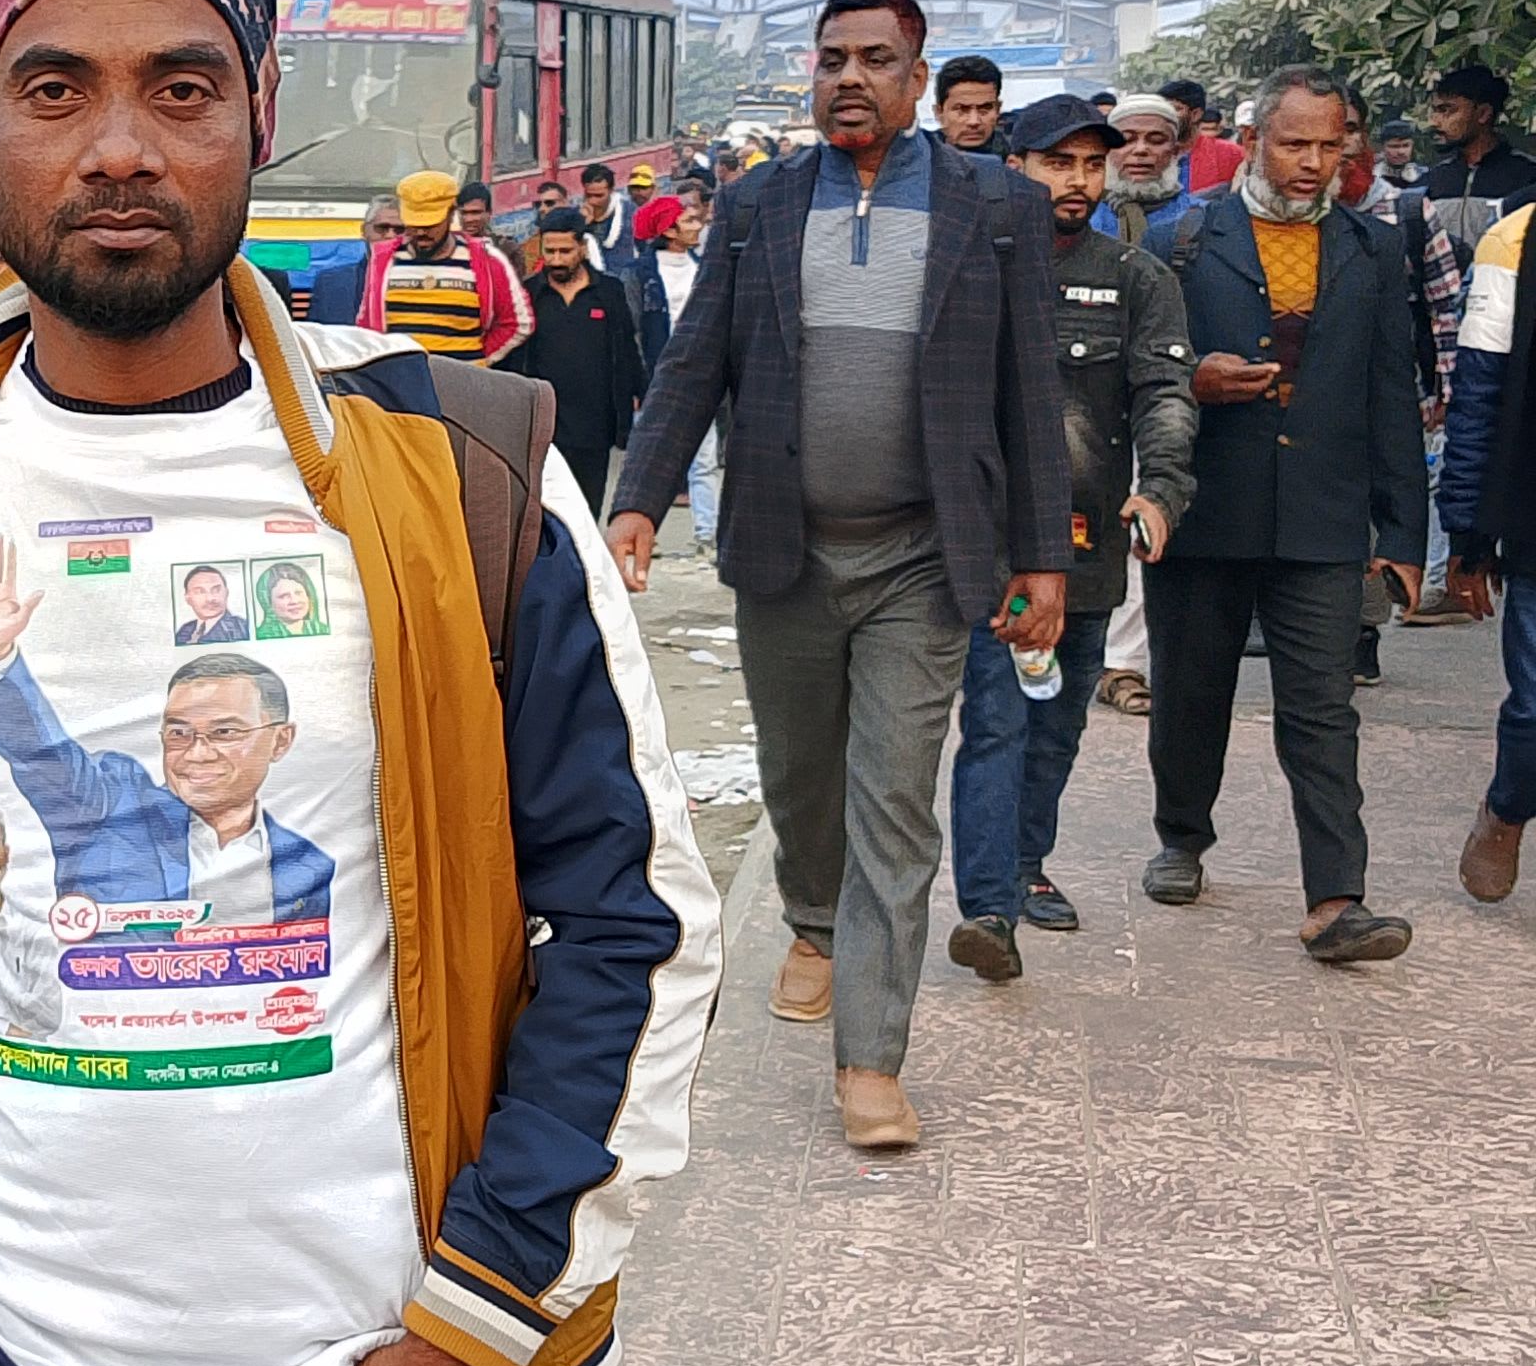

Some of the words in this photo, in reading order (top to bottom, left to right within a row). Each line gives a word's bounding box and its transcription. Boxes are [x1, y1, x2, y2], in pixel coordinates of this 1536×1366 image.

[56, 907, 93, 930] ২৫
[157, 908, 197, 921] ২০২৫
[68, 955, 122, 978] জনাব
[125, 948, 232, 983] তারেক
[234, 939, 327, 979] রহমান
[74, 1055, 130, 1081] বাবর
